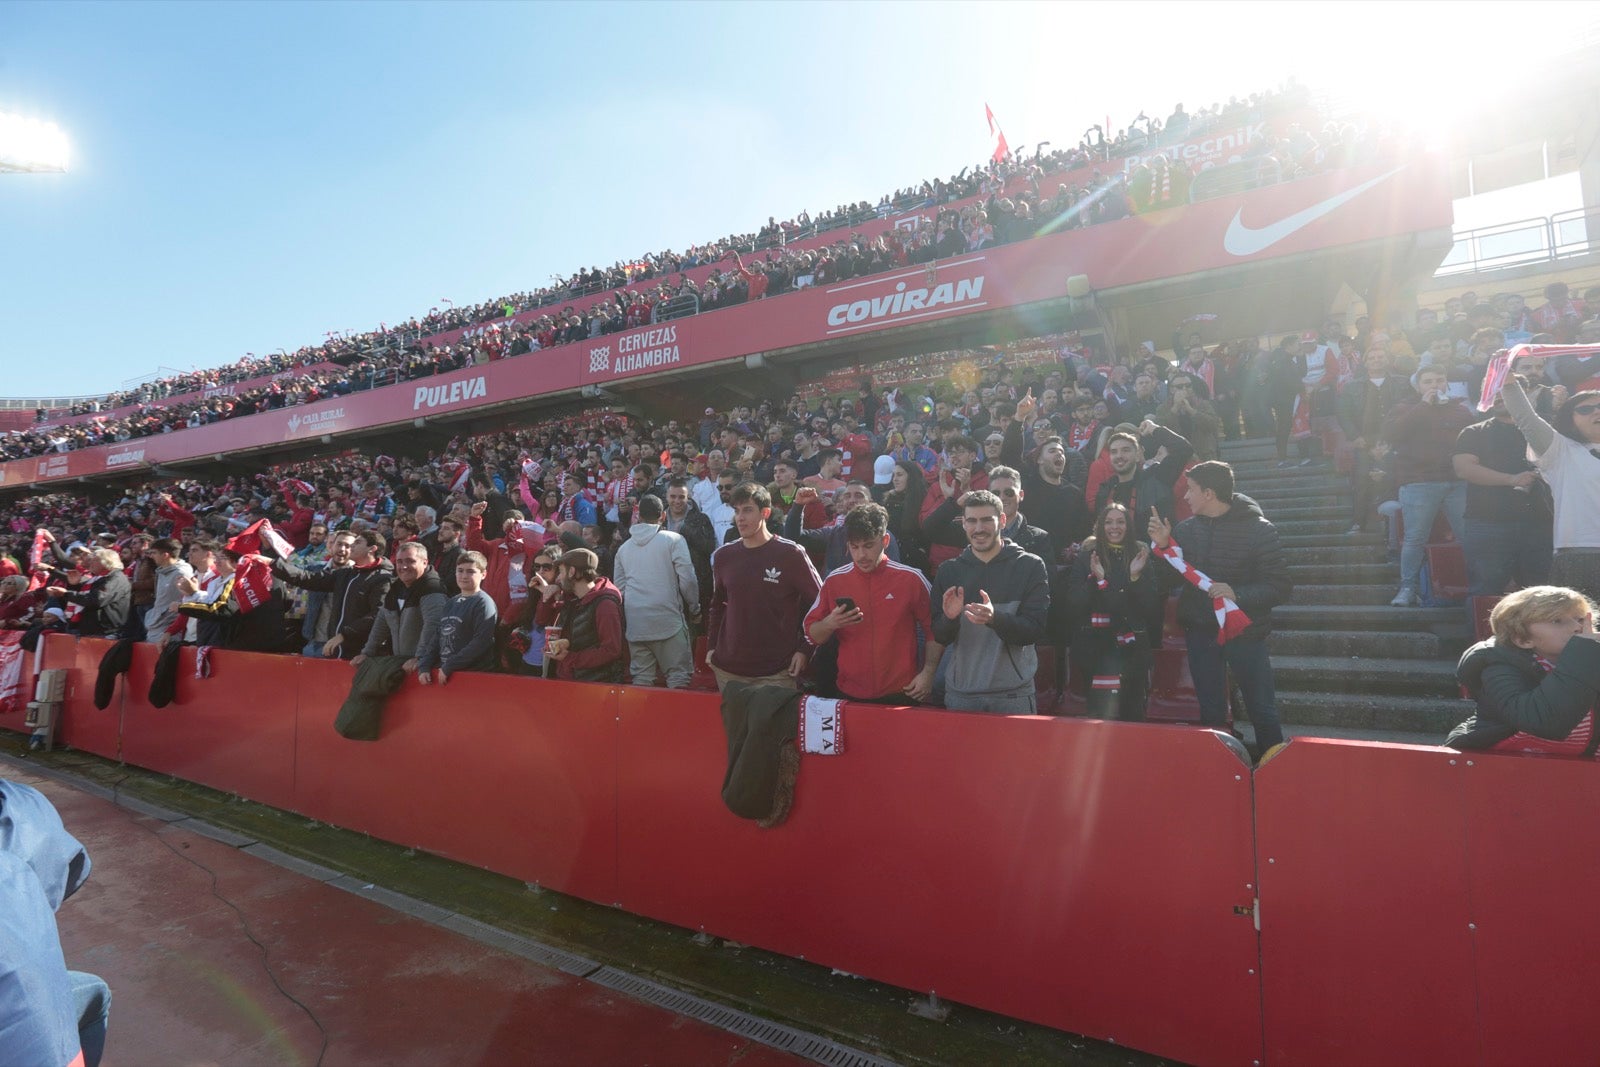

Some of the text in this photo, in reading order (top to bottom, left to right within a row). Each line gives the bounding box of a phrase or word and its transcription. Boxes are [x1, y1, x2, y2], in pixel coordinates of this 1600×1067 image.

[618, 325, 677, 353] CERVEZAS
[614, 345, 680, 374] ALHAMBRA
[413, 376, 487, 410] PULEVA
